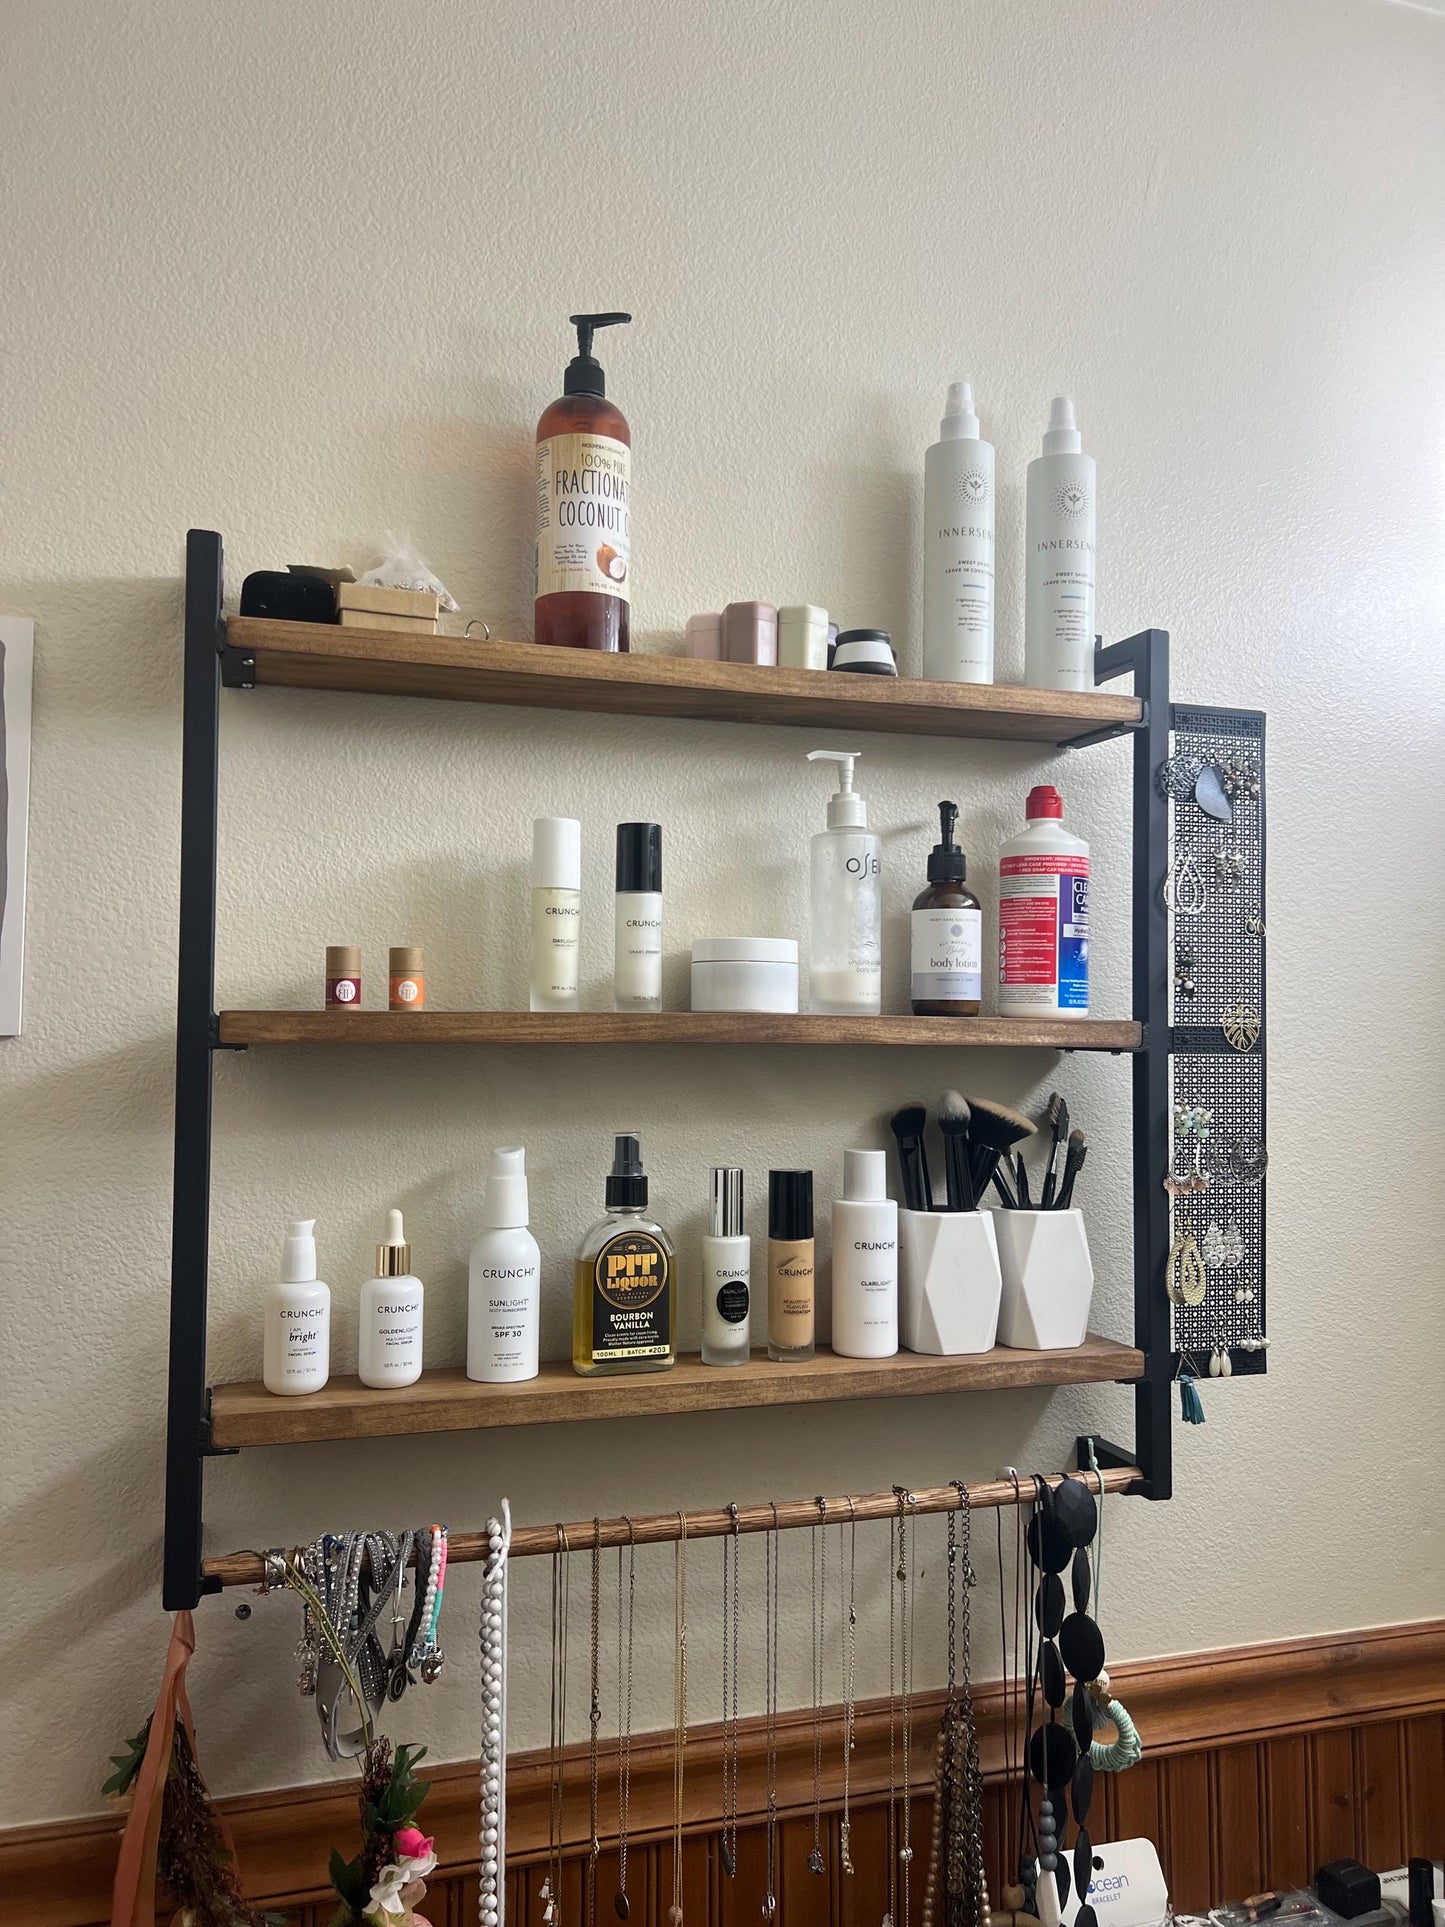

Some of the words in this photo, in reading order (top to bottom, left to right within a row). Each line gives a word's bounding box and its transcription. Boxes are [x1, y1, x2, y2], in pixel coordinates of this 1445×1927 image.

[581, 452, 610, 470] 100%
[614, 459, 626, 476] PURE
[559, 500, 621, 532] COCONUT
[846, 853, 881, 880] OSE
[1074, 881, 1088, 893] CLE
[930, 958, 954, 970] body
[956, 958, 978, 968] lotion
[607, 1253, 658, 1277] PIT
[606, 1275, 658, 1292] LIQUOR
[610, 1312, 654, 1321] BOURBON
[614, 1321, 650, 1329] VANILLA
[289, 1332, 316, 1343] bright
[1092, 1893, 1121, 1904] BRACELET
